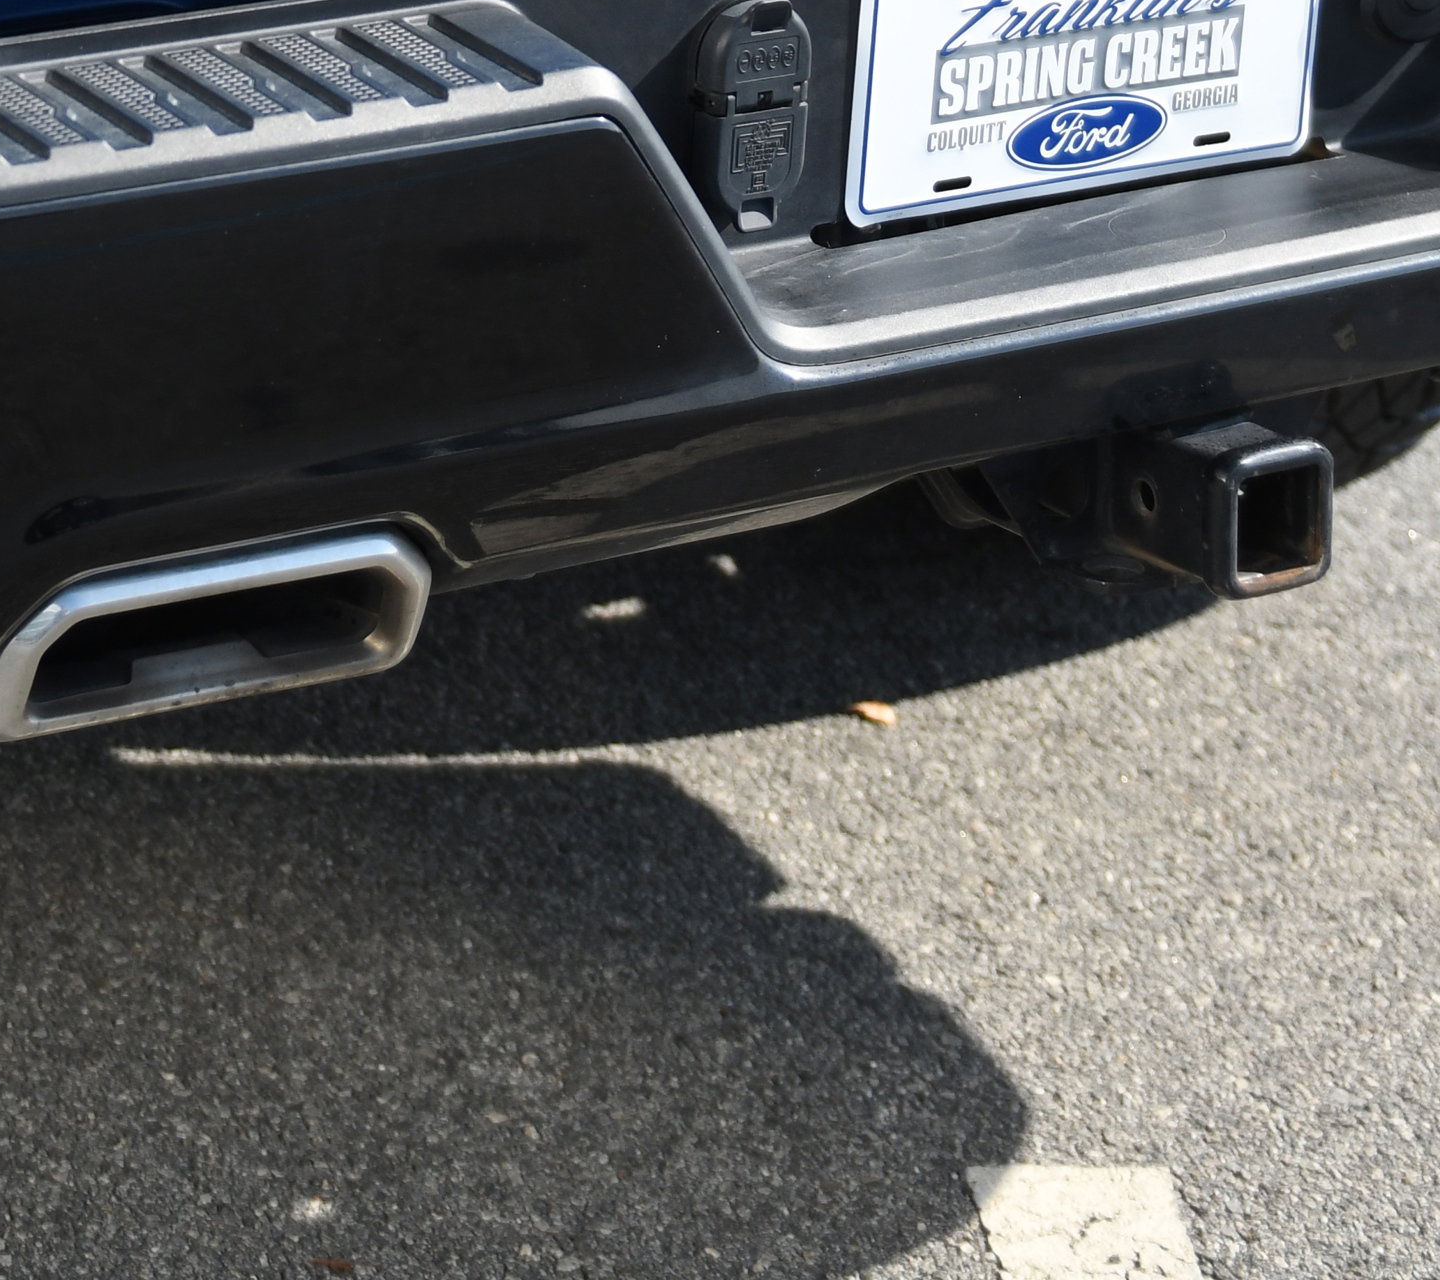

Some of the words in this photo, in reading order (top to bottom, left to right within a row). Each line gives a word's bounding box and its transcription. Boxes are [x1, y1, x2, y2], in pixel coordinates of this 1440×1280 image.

[938, 37, 1097, 117] SPRING
[1103, 16, 1240, 90] CREEK
[1171, 83, 1239, 112] GEORGIA
[926, 120, 1007, 153] COLQUITT
[1039, 105, 1135, 159] Ford
